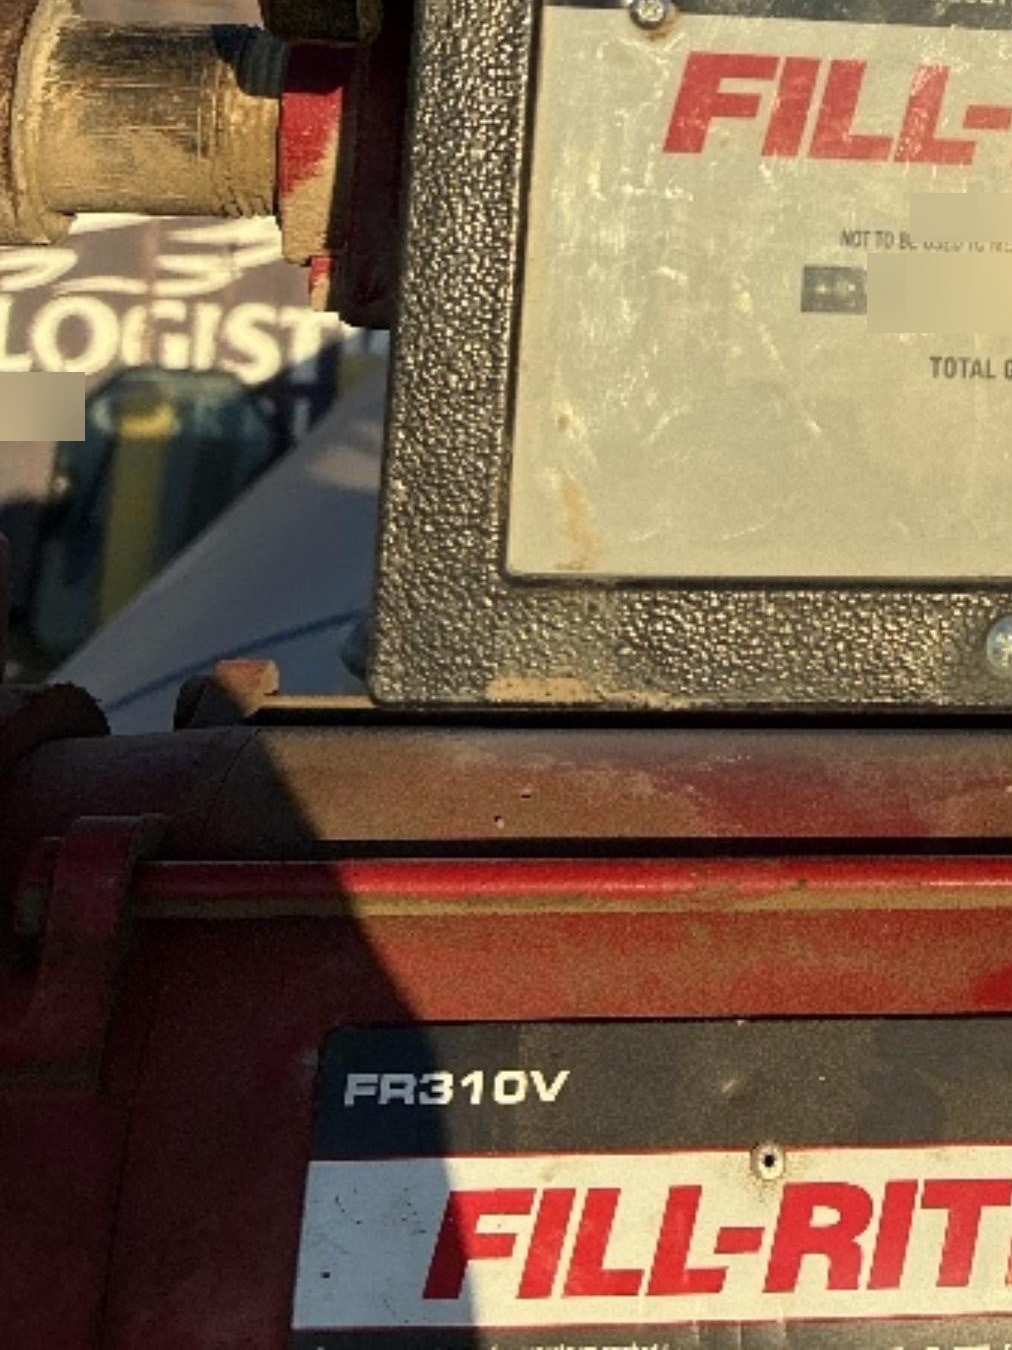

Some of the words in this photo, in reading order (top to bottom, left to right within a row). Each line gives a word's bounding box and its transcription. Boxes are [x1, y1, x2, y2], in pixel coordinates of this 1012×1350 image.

[840, 230, 870, 249] NOT
[875, 230, 894, 250] TO
[930, 356, 996, 380] TOTAL
[343, 1069, 570, 1106] FR310V
